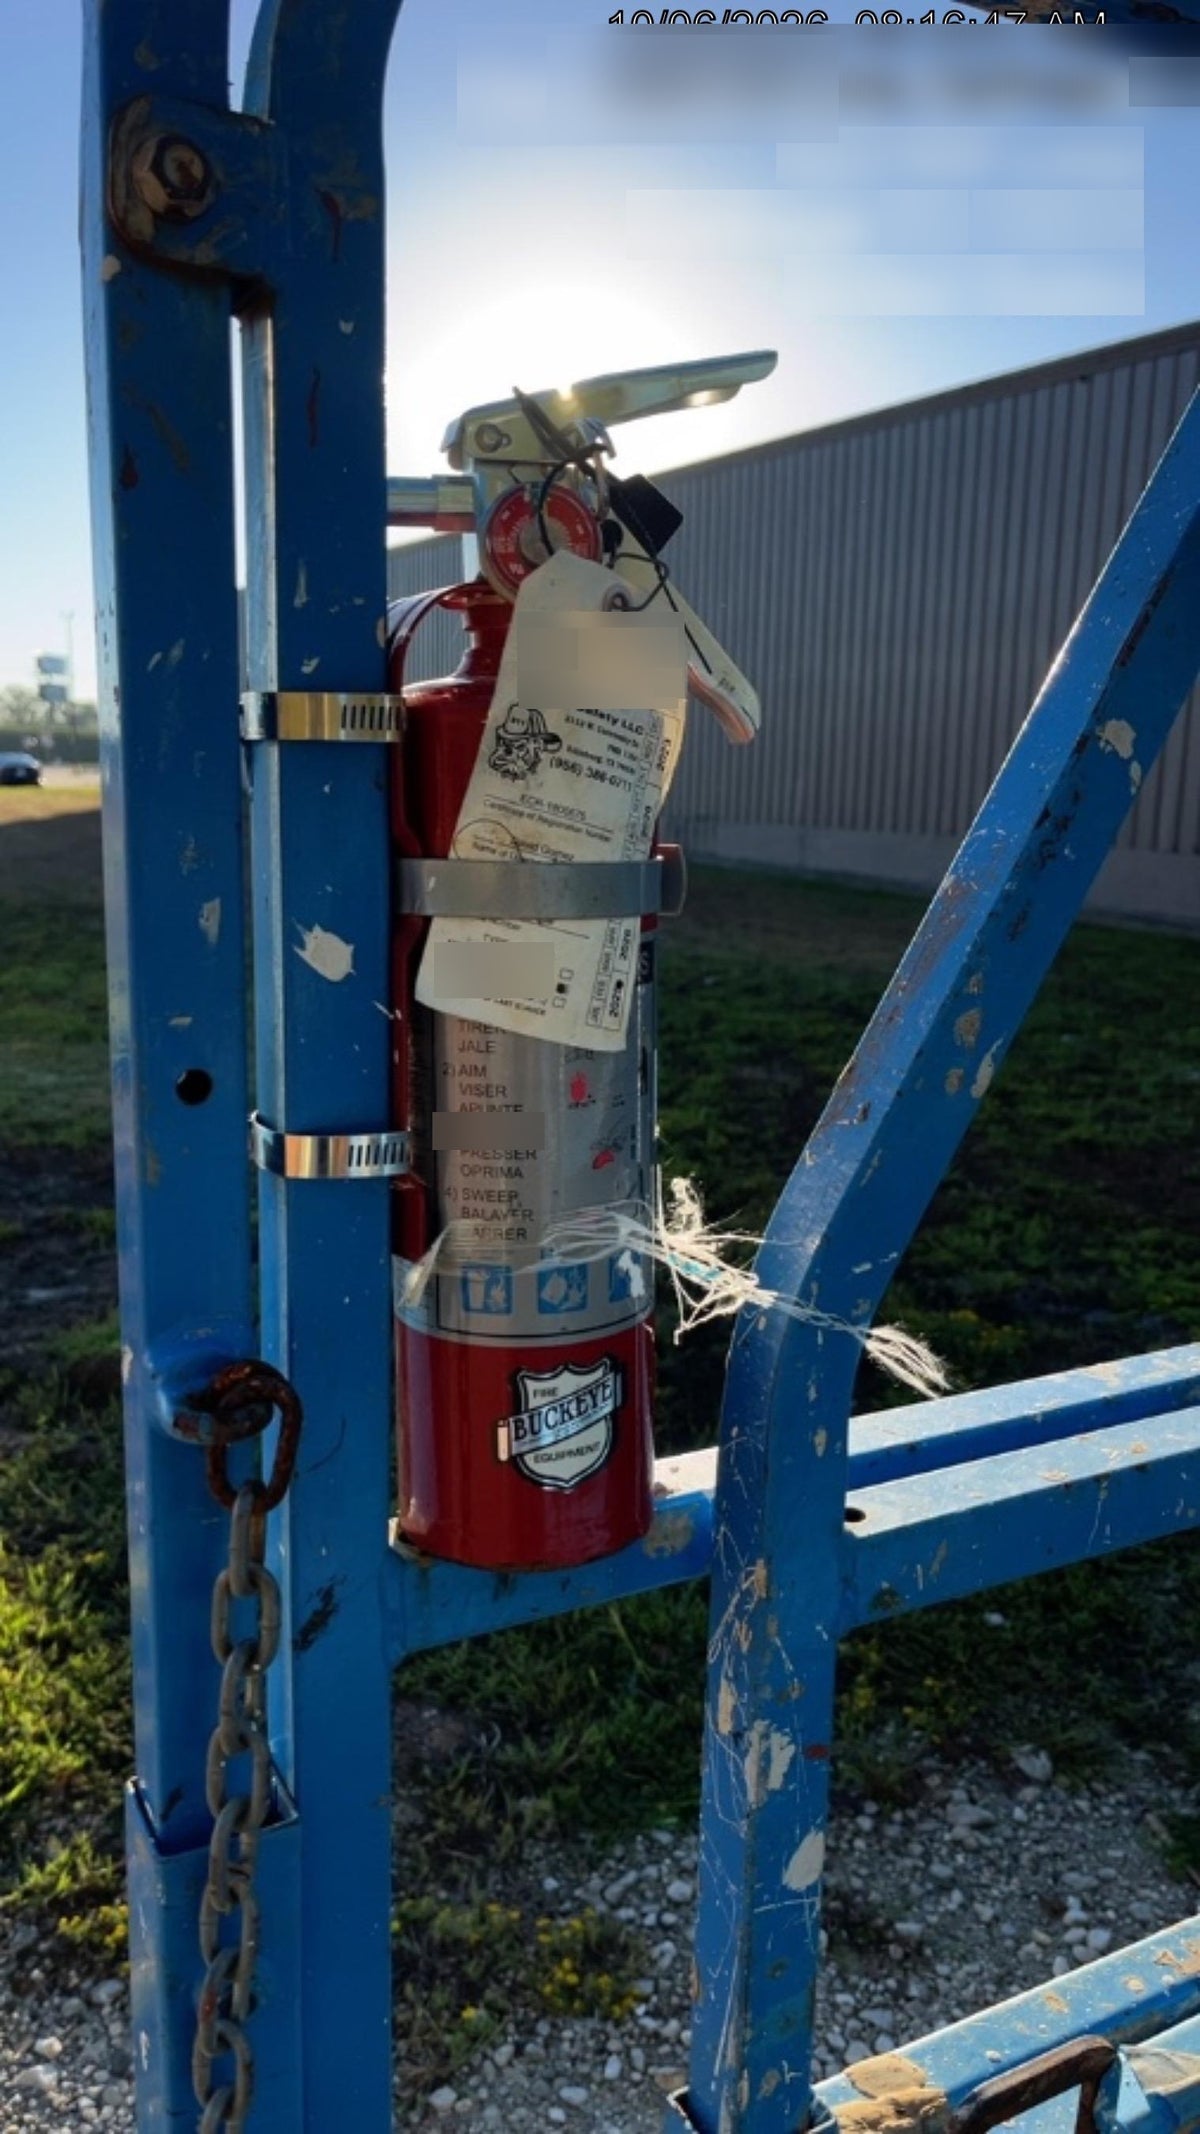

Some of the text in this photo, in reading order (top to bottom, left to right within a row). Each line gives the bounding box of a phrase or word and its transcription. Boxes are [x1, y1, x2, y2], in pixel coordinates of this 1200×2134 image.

[458, 1040, 497, 1054] JALE
[458, 1063, 487, 1078] AIM
[459, 1083, 508, 1098] VISER
[461, 1163, 524, 1179] OPRIMA
[462, 1187, 518, 1204] SWEEP
[462, 1205, 535, 1222] BALAYER
[533, 1387, 559, 1399] FIRE
[513, 1380, 612, 1441] BUCKEYE
[533, 1441, 601, 1463] EQUIPMENT
